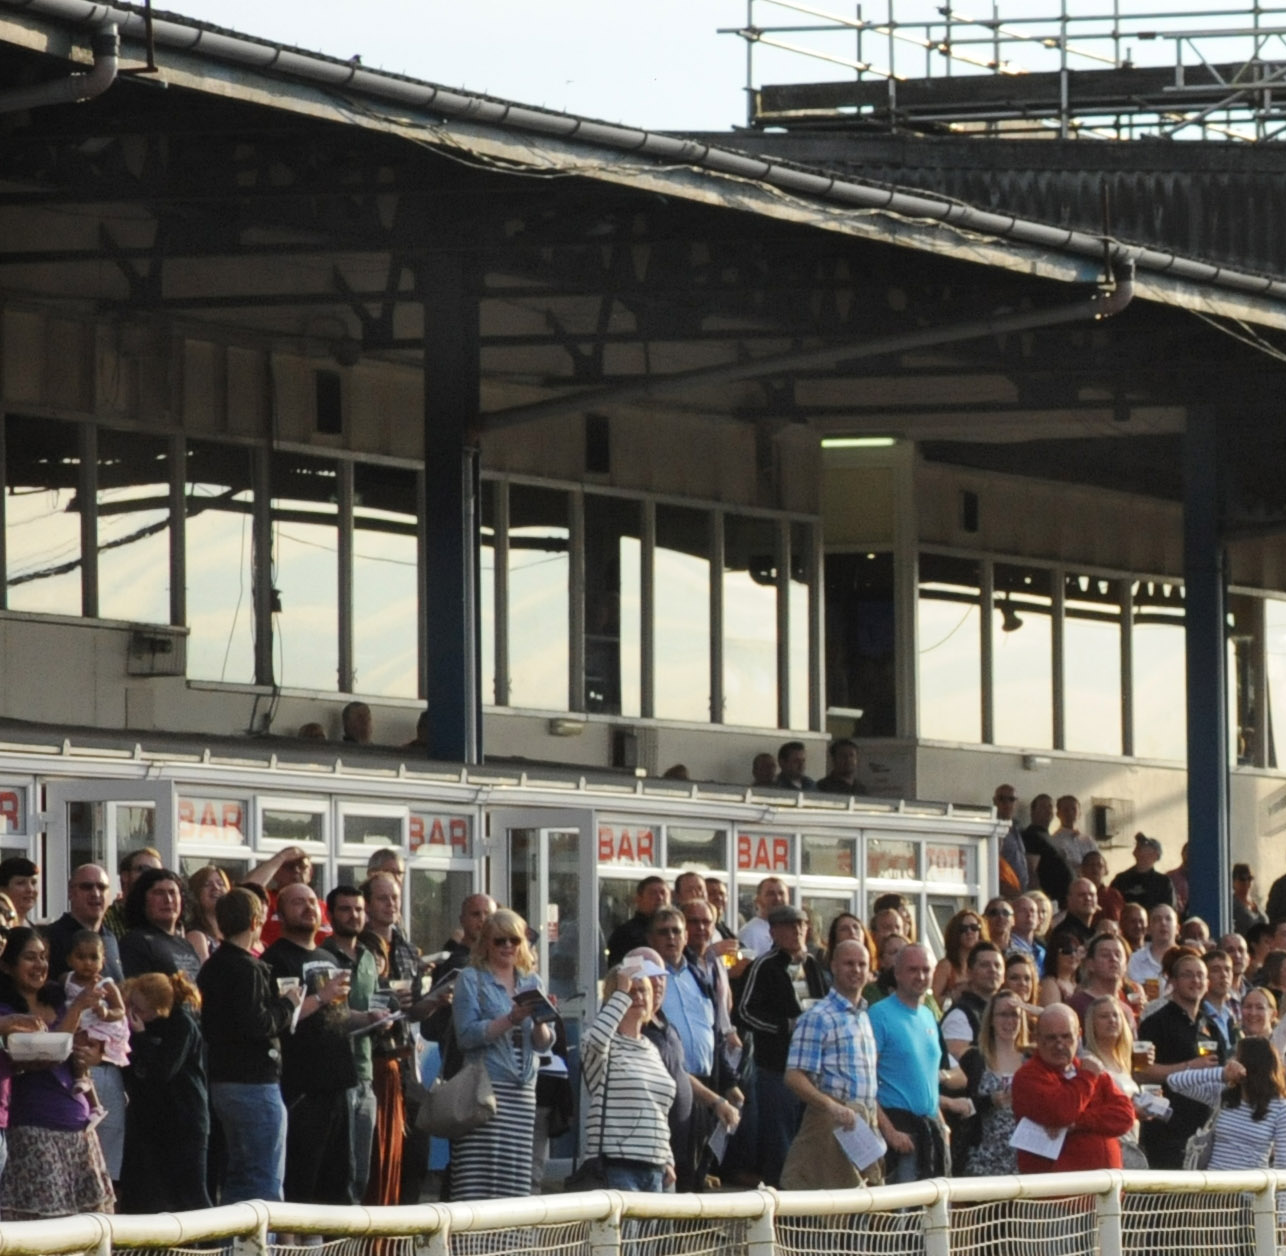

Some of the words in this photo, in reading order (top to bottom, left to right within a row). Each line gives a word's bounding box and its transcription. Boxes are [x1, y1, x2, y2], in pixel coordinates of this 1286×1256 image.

[178, 801, 244, 839] BAR
[409, 816, 467, 854] BAR
[598, 827, 653, 864] BAR
[738, 836, 788, 870] BAR
